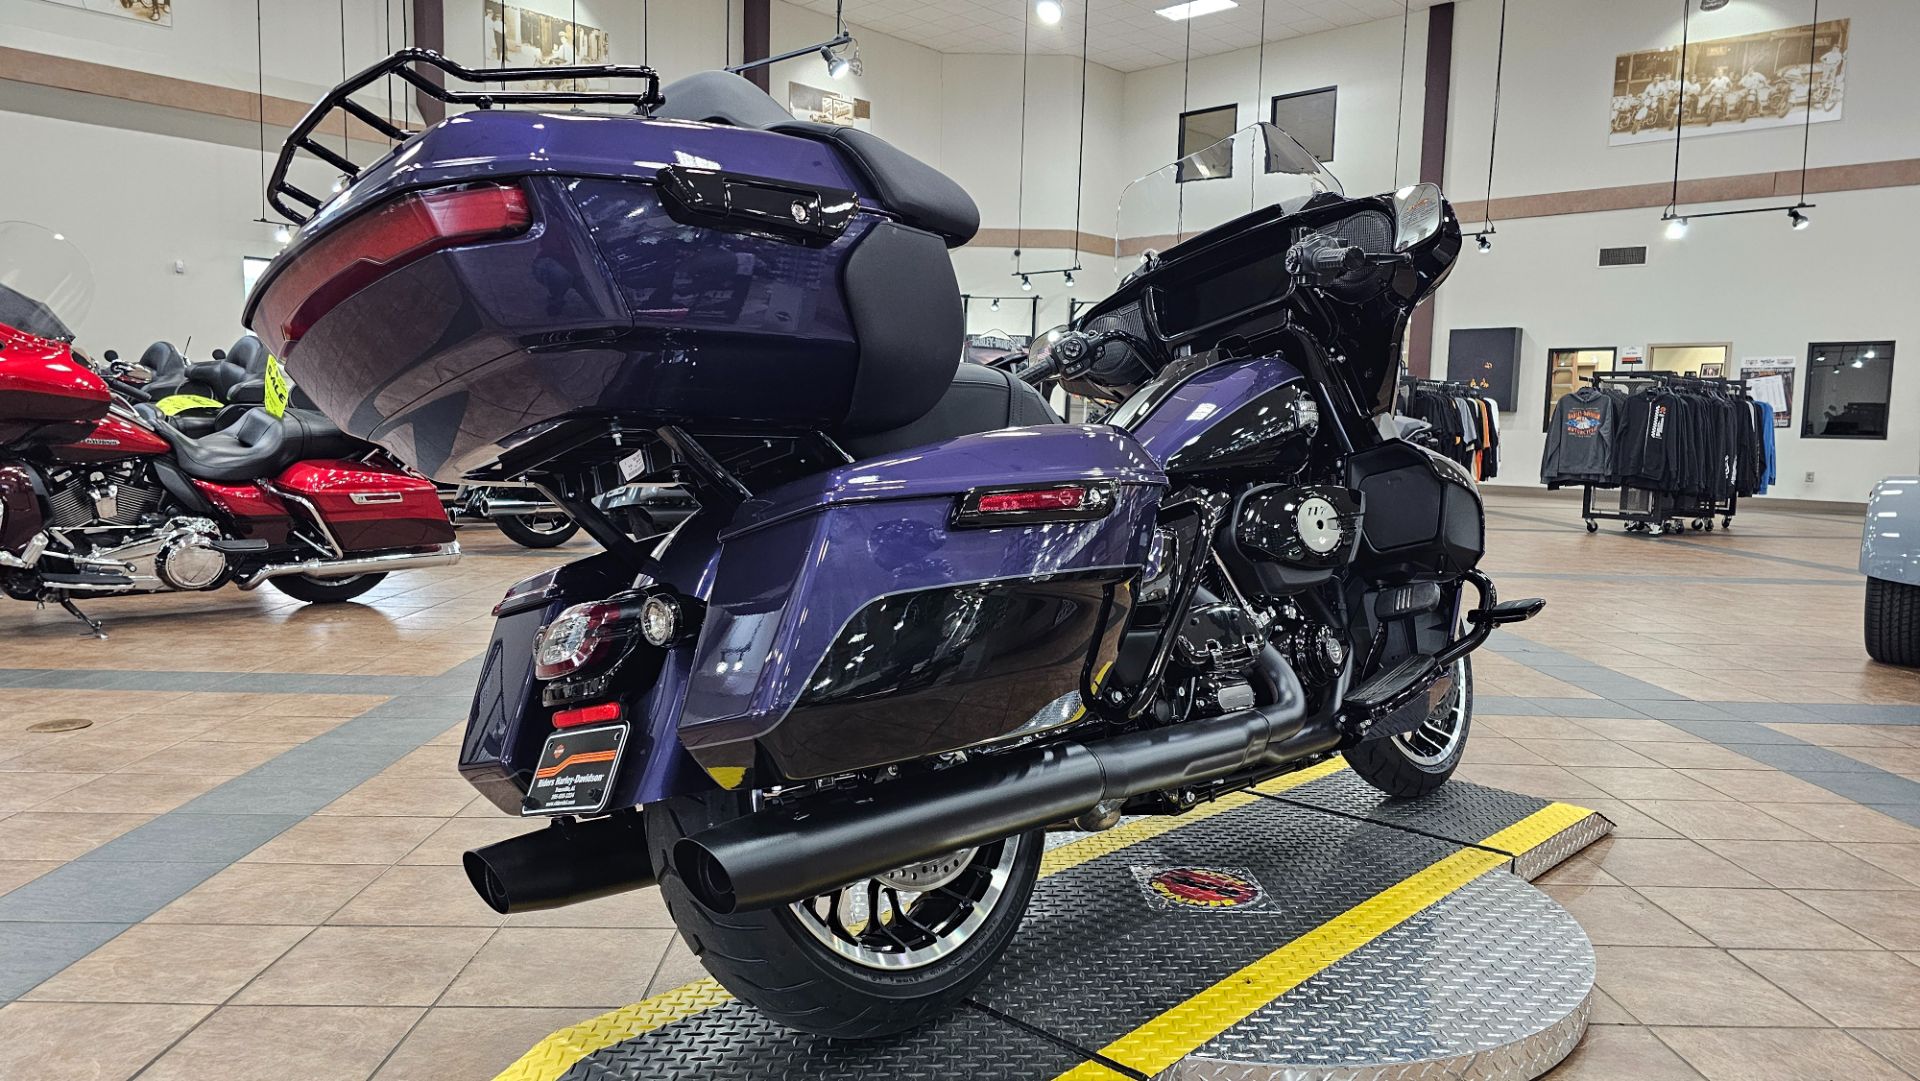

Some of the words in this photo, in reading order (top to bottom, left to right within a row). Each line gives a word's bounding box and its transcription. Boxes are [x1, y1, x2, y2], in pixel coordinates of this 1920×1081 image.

[268, 365, 286, 404] SALE
[1308, 506, 1327, 516] 117
[555, 774, 603, 786] Harley-Davidson
